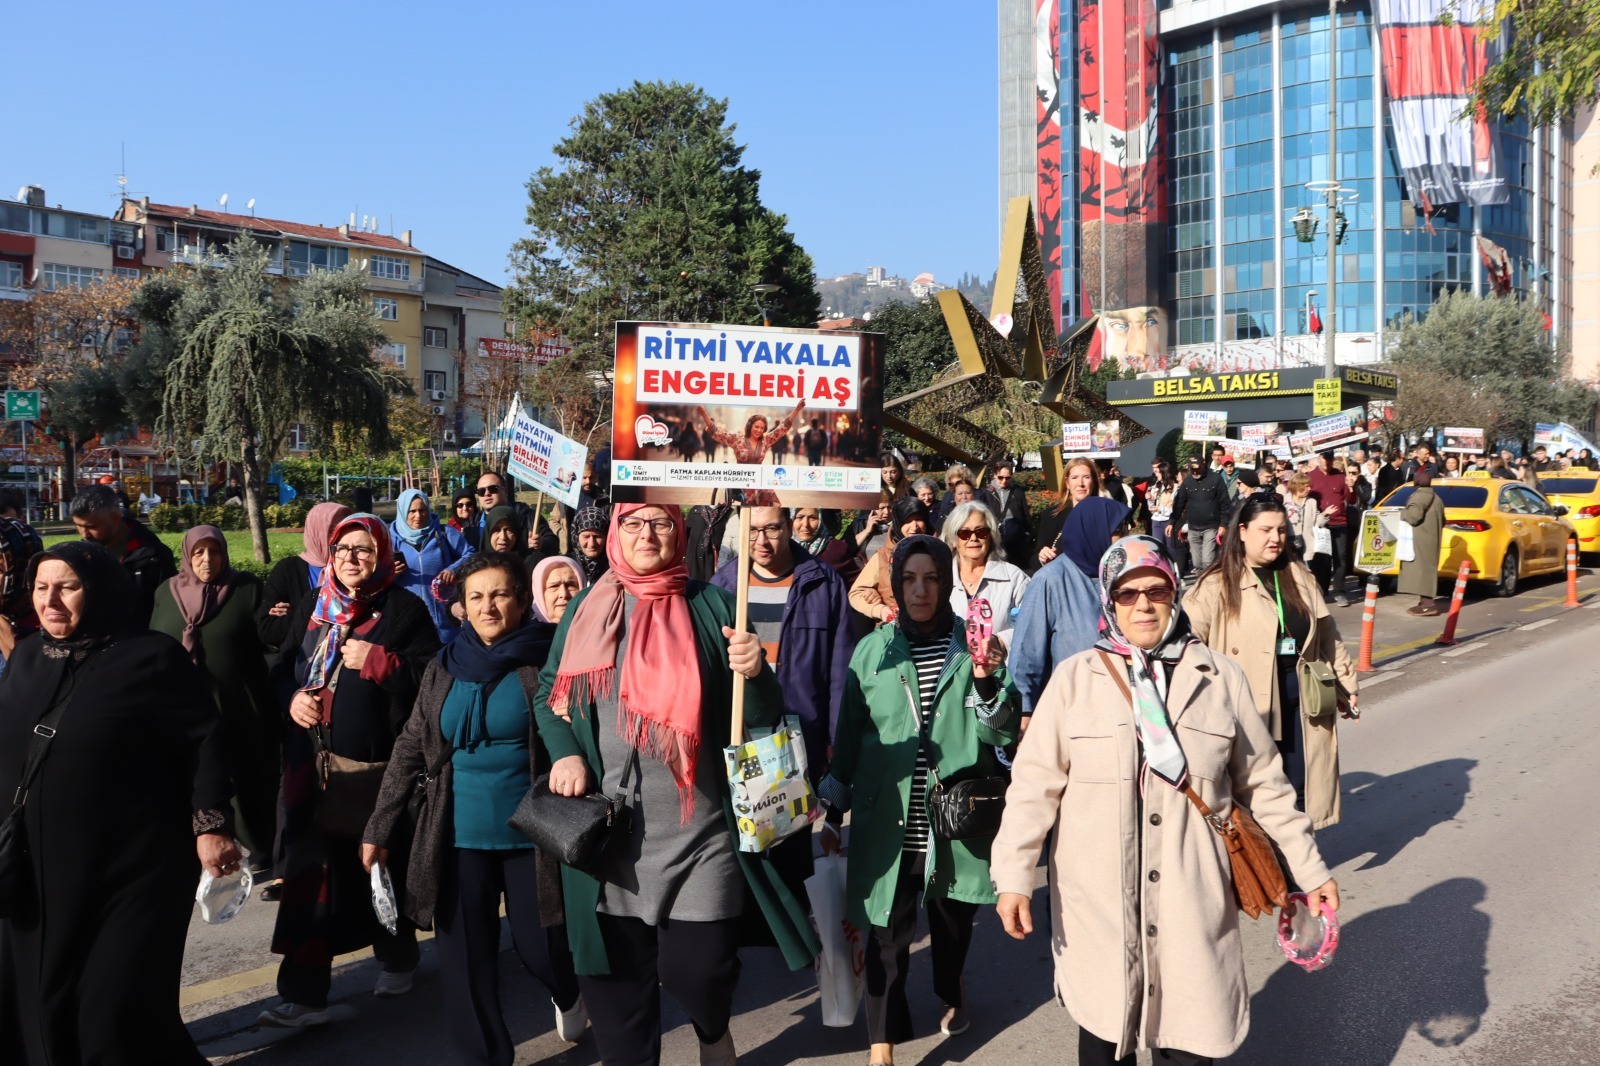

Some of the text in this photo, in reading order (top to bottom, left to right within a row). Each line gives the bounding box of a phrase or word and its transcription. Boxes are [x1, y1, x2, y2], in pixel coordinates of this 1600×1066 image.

[644, 330, 851, 368] RİTMİ YAKALA
[1153, 376, 1216, 396] BELSA
[1316, 382, 1339, 390] BELSA
[1347, 369, 1373, 385] BELSA
[643, 368, 851, 407] ENGELLERİ AŞ
[1188, 411, 1208, 419] AYNI
[1310, 415, 1348, 429] HAKLARIMIZ
[518, 418, 554, 444] HAYATIN
[1064, 425, 1089, 434] EŞİTLİK
[516, 431, 552, 458] RİTMİNİ
[512, 454, 547, 476] YAKALAYALIM
[513, 444, 550, 470] BİRLİKTE
[723, 469, 756, 477] HÜRRİYET
